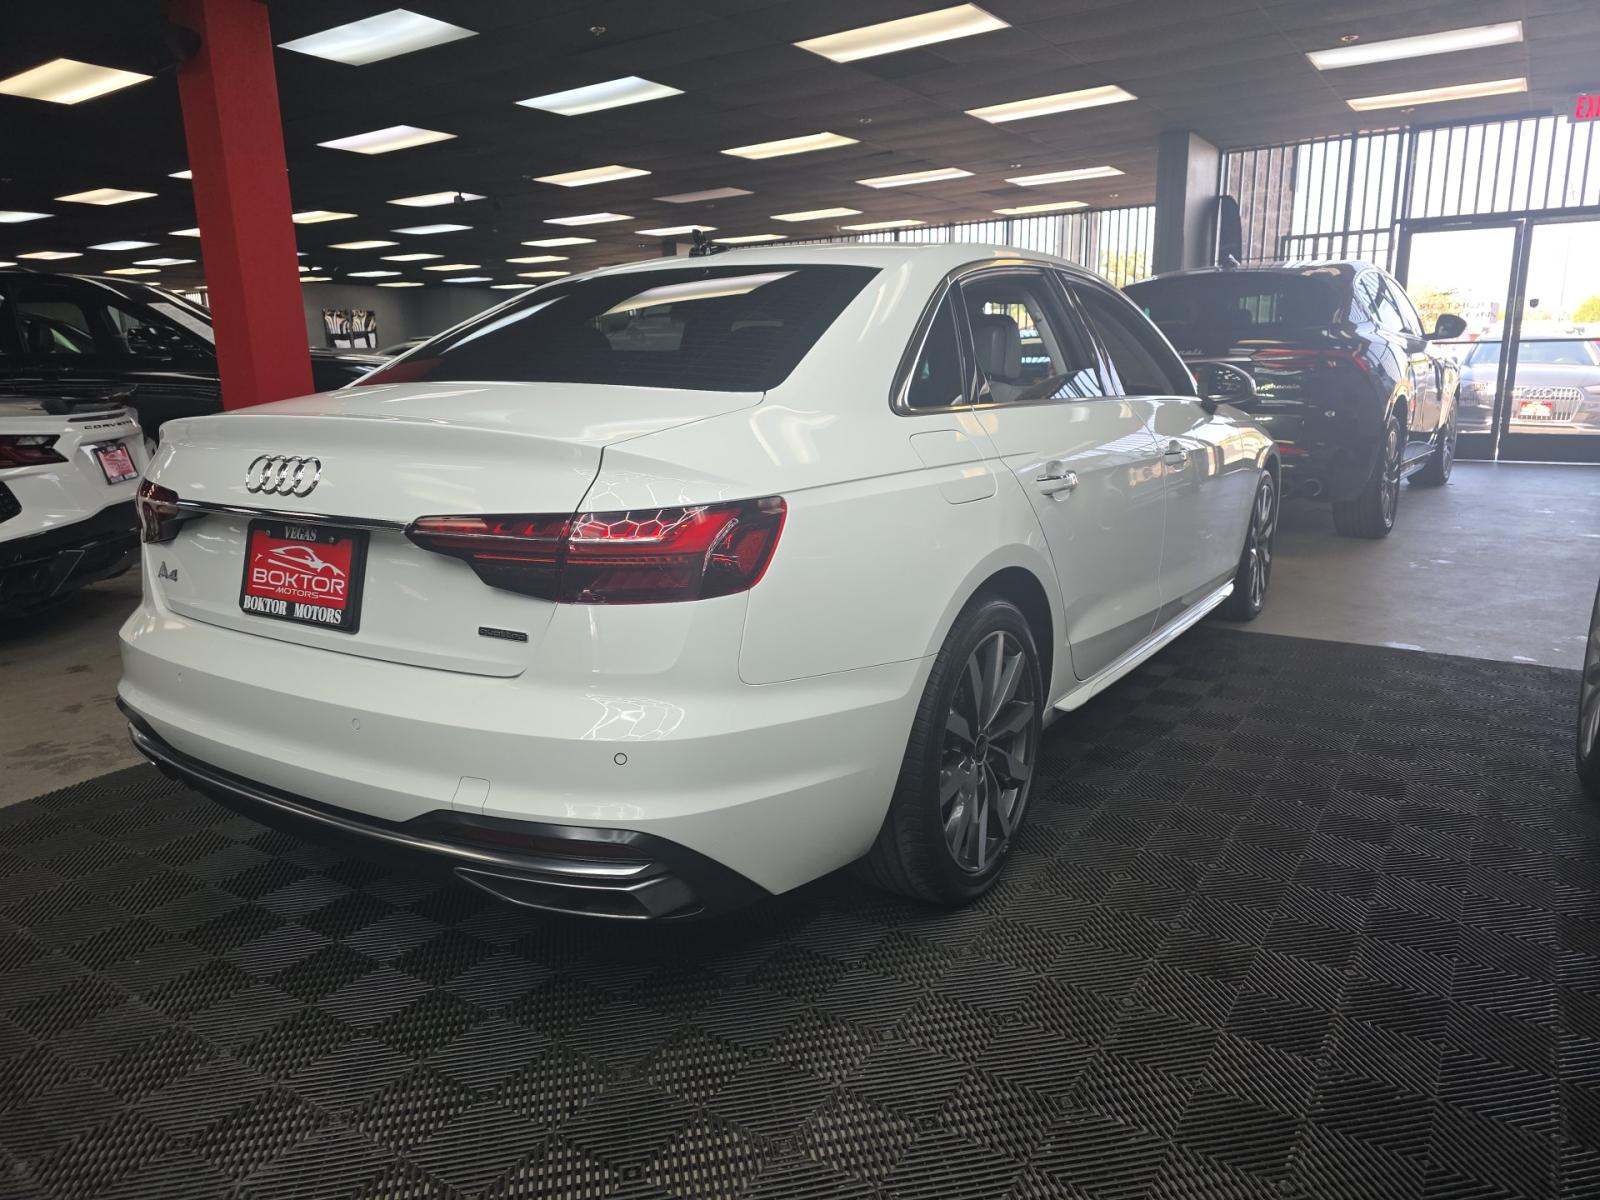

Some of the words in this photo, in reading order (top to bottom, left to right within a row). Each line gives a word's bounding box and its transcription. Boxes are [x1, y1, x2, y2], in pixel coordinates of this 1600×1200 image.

[285, 526, 317, 540] VEGAS
[158, 560, 178, 582] A4
[252, 567, 345, 595] BOKTOR
[275, 587, 319, 599] MOTORS
[244, 595, 287, 615] BOKTOR
[294, 603, 342, 624] MOTORS
